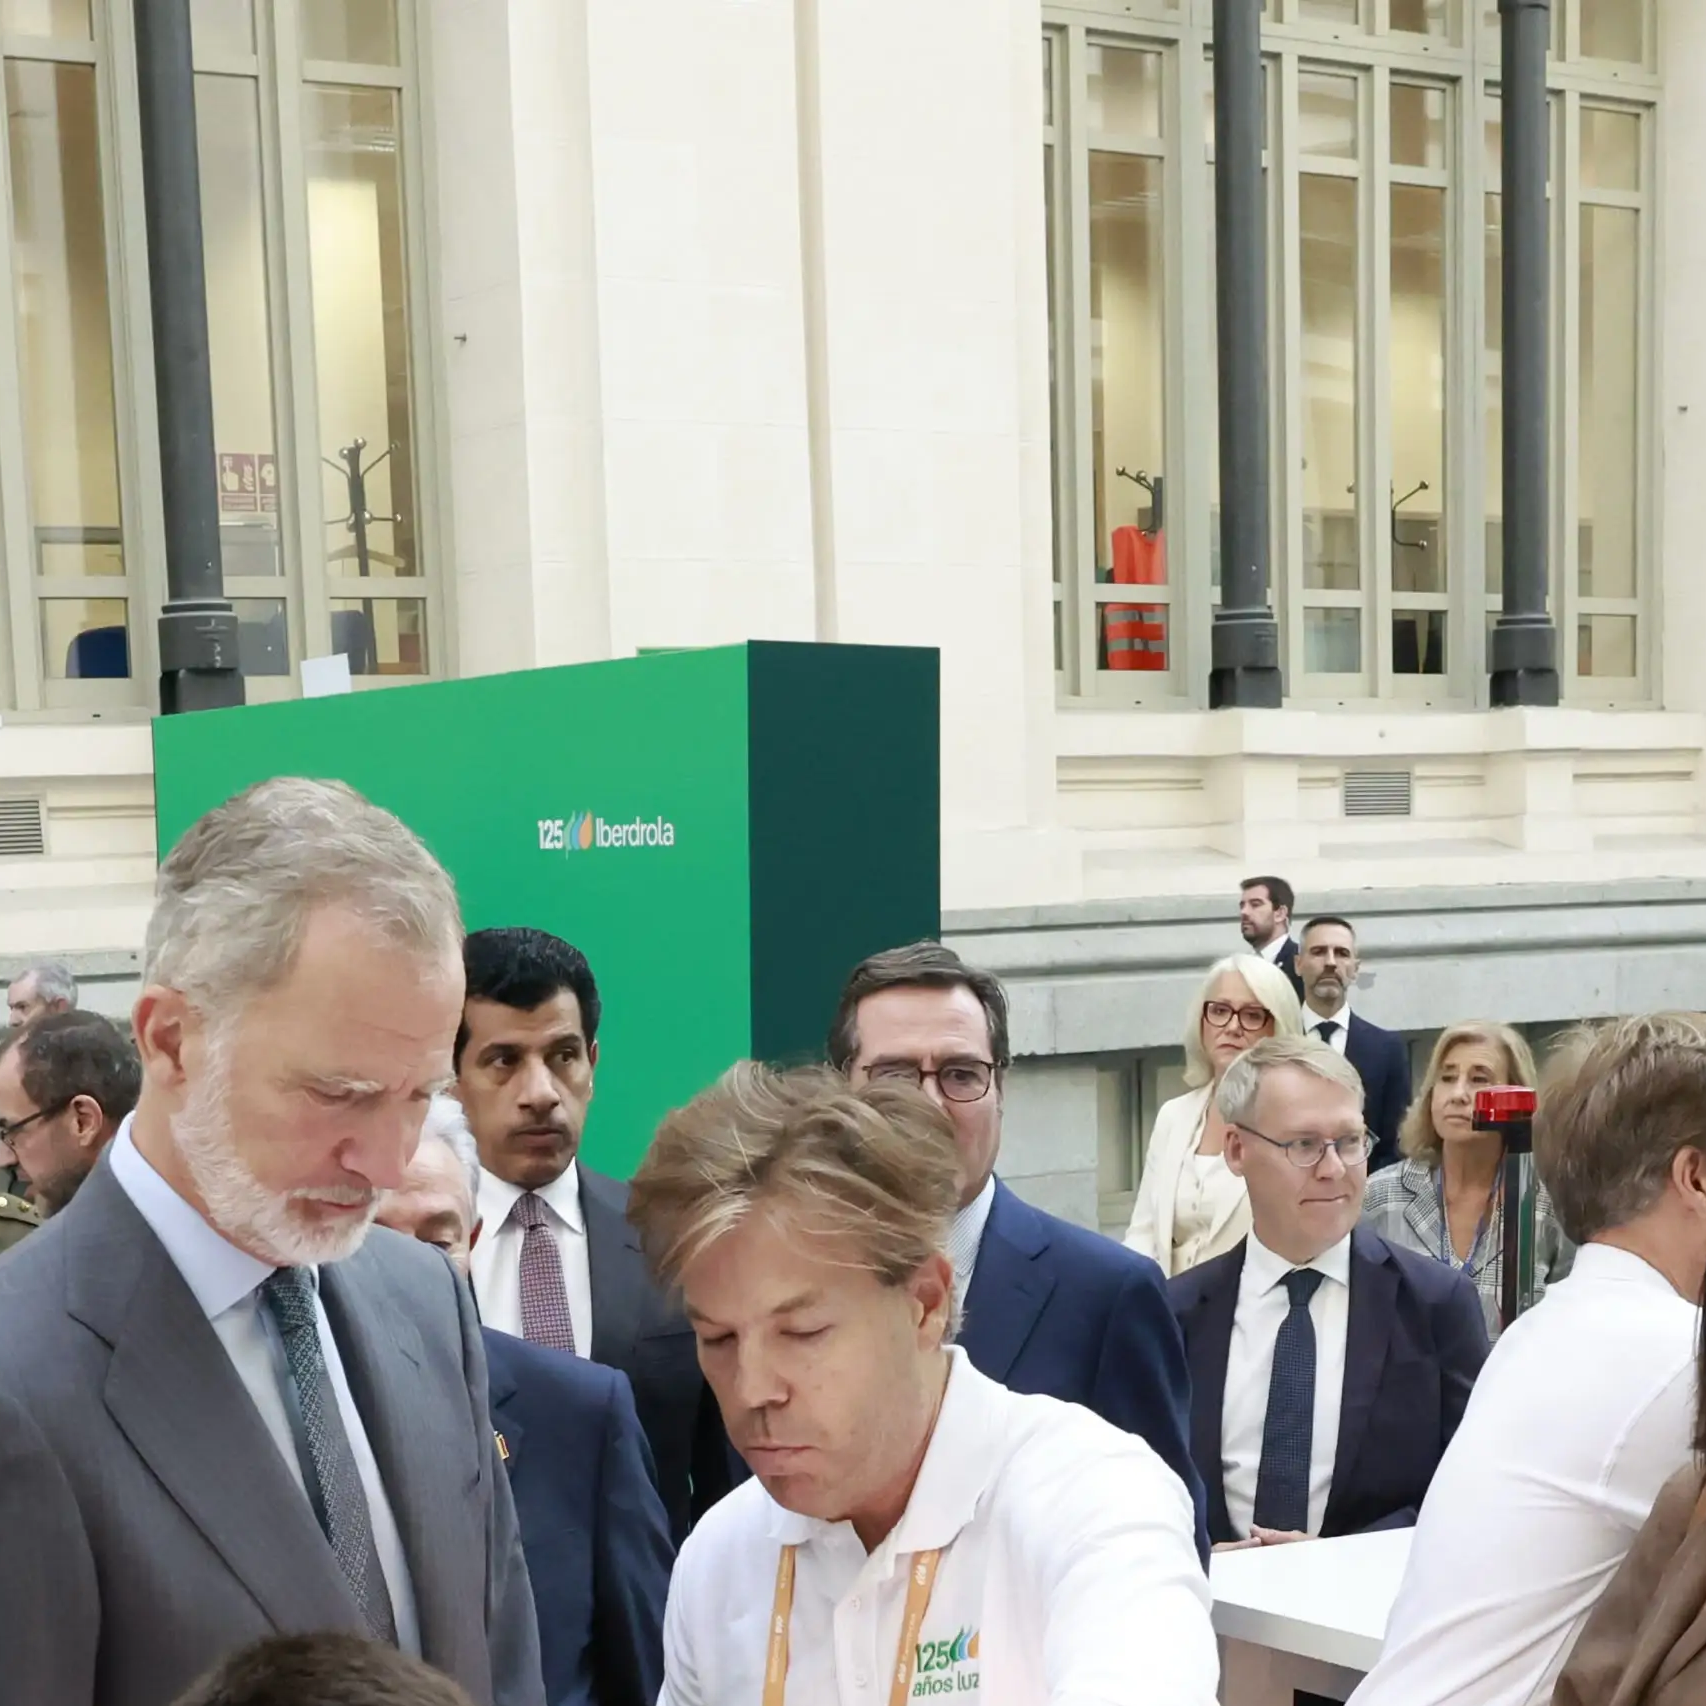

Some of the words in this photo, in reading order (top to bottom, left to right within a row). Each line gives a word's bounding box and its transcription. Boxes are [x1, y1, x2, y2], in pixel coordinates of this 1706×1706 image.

[537, 819, 564, 850] 125
[596, 816, 675, 847] Iberdrola
[915, 1640, 950, 1673] 125
[912, 1675, 953, 1697] años
[957, 1670, 980, 1692] luz
